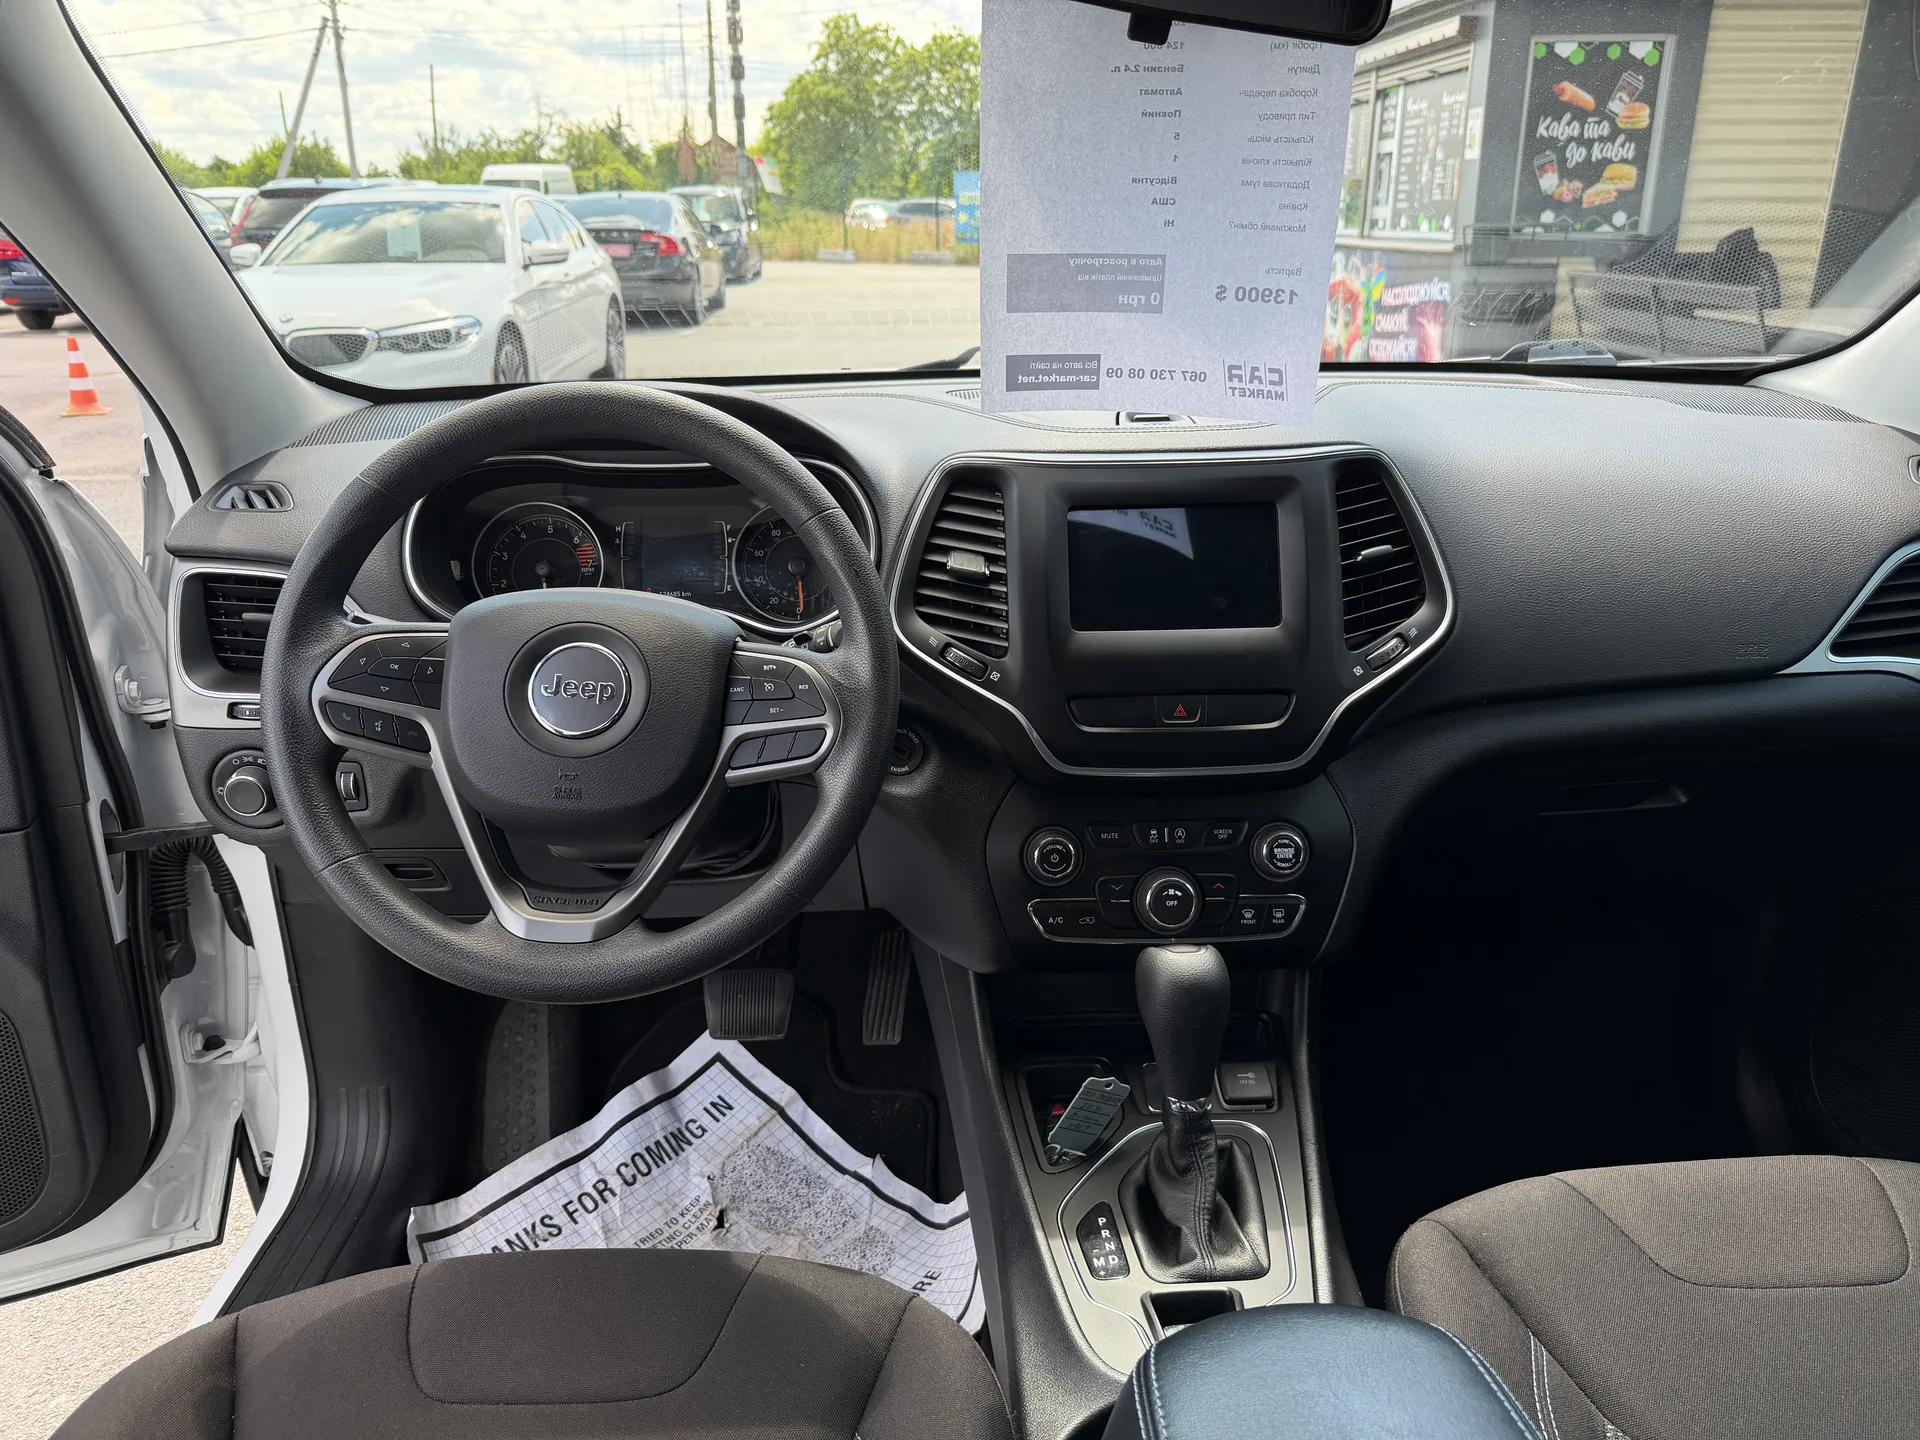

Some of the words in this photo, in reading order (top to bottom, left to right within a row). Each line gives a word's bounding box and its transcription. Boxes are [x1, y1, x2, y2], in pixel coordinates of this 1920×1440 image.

[1536, 112, 1580, 140] Кава
[1583, 117, 1610, 139] та
[1565, 141, 1588, 169] до
[1590, 133, 1636, 162] кави
[547, 525, 554, 534] 5
[771, 529, 781, 537] 80
[520, 532, 527, 540] 4
[573, 536, 580, 545] 6
[501, 551, 508, 561] 3
[586, 559, 593, 568] 7
[500, 579, 507, 588] 2
[769, 597, 779, 605] 20
[389, 663, 399, 671] OK
[540, 673, 617, 705] Jeep
[1101, 832, 1119, 840] MUTE
[532, 895, 572, 905] SINCE
[575, 898, 600, 906] 1941
[486, 1213, 563, 1253] ANKS
[561, 1177, 618, 1226] FOR
[615, 1117, 708, 1187] COMING
[702, 1094, 736, 1124] IN
[682, 1200, 713, 1230] CLEAN
[633, 1227, 665, 1248] TRIED
[663, 1216, 680, 1230] TO
[678, 1194, 702, 1218] KEEP
[1097, 1217, 1107, 1226] P
[1100, 1229, 1111, 1239] R
[1104, 1241, 1116, 1252] N
[1092, 1256, 1106, 1268] M
[1108, 1255, 1119, 1265] D
